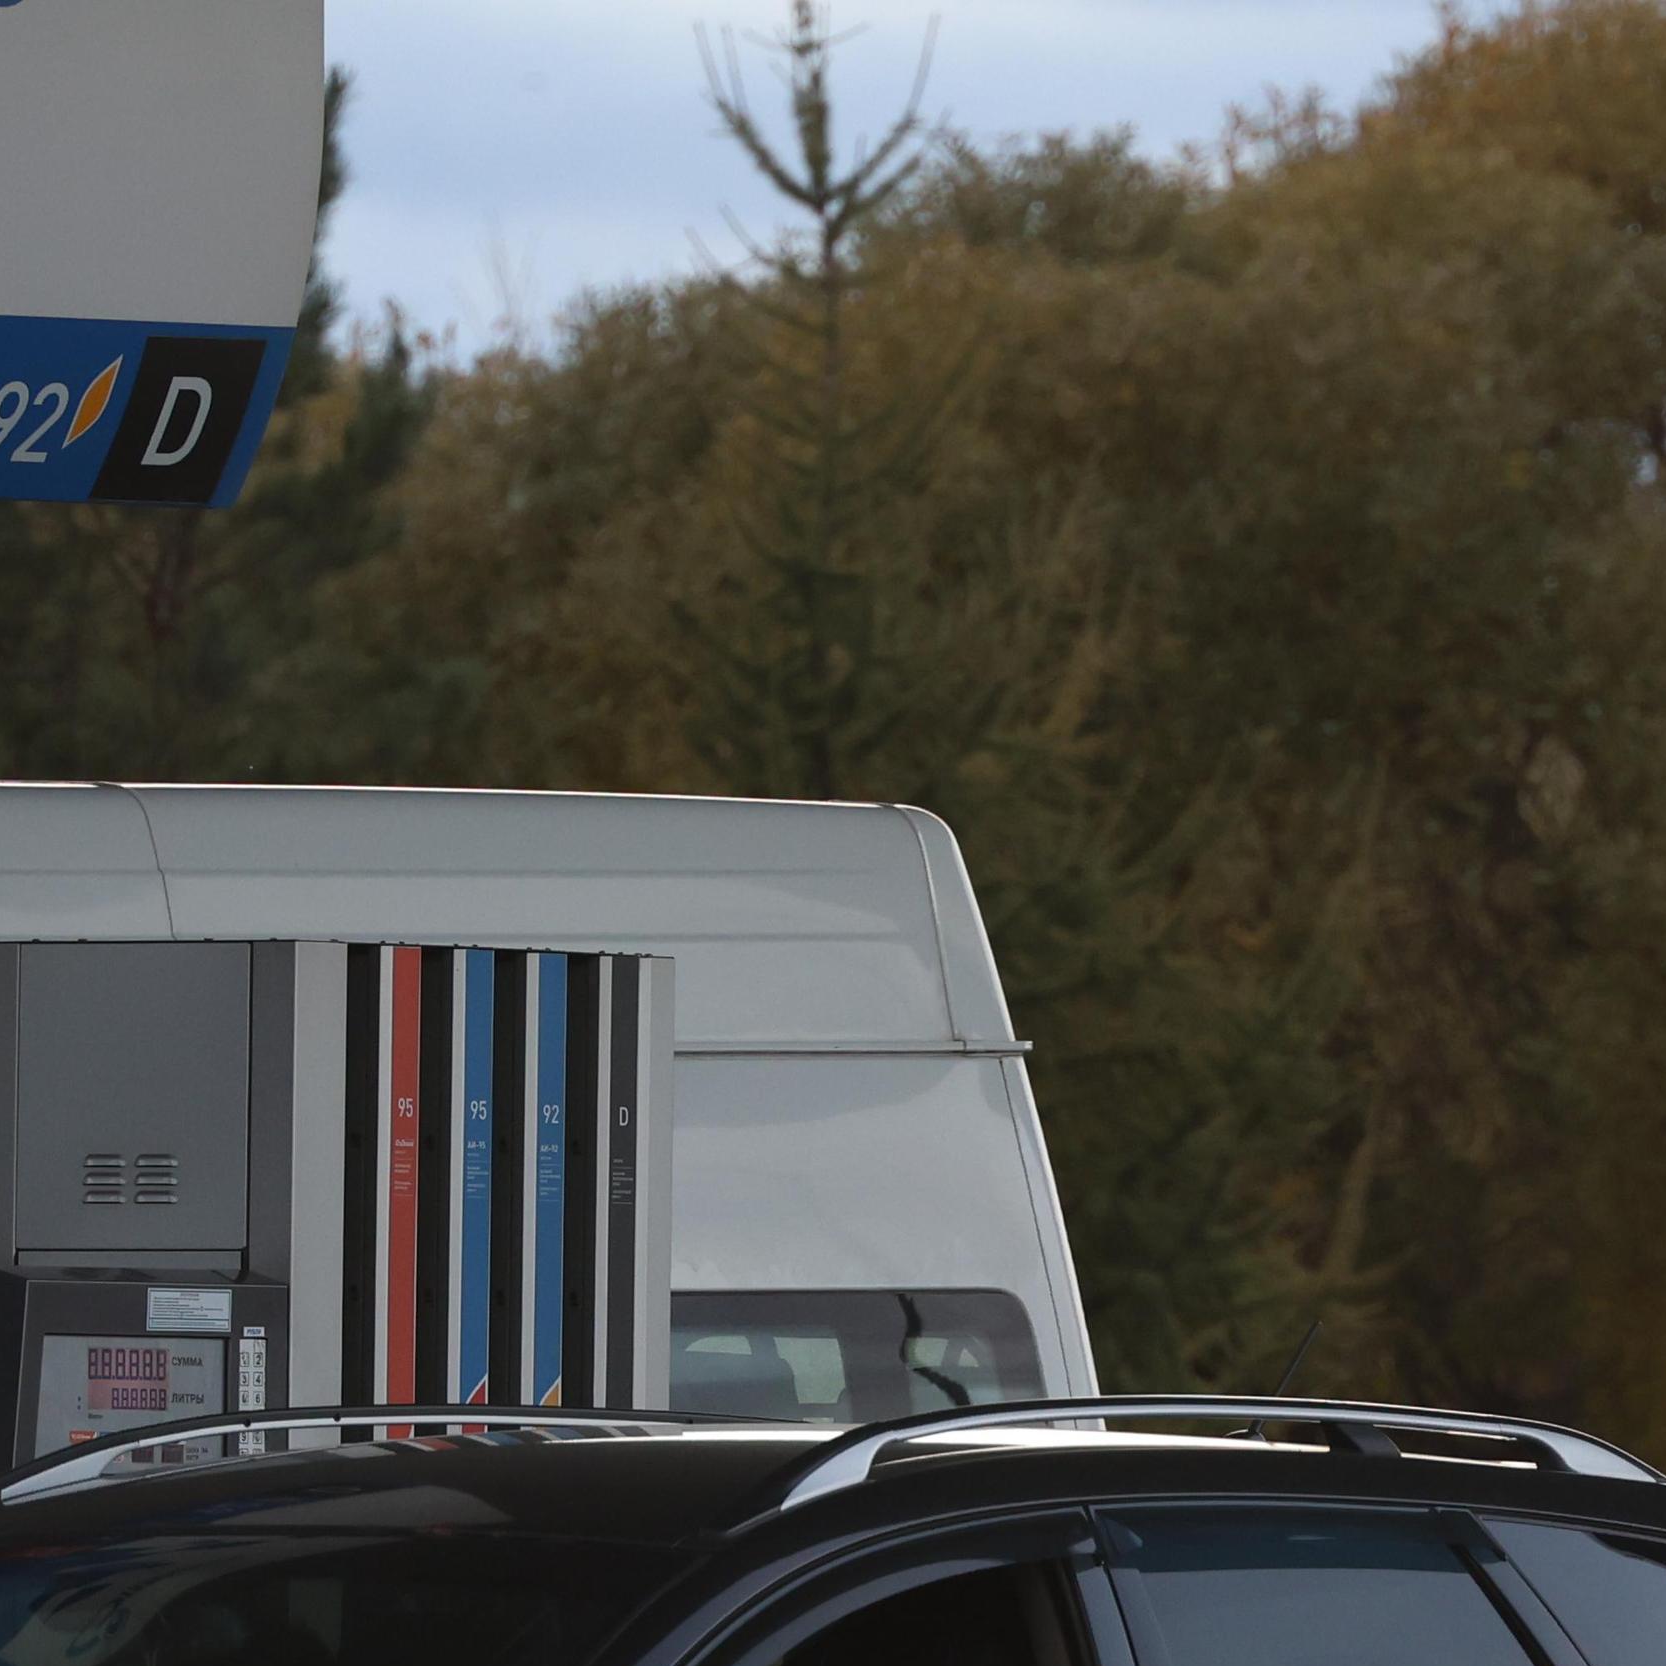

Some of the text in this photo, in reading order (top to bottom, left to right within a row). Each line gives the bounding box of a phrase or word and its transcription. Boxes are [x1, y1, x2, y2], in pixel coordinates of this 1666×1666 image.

[141, 375, 212, 467] D
[397, 1097, 414, 1118] 95
[470, 1100, 487, 1121] 95
[542, 1104, 560, 1125] 92
[619, 1106, 629, 1127] D
[171, 1356, 204, 1367] СУММА
[170, 1393, 204, 1404] ЛИТРЫ
